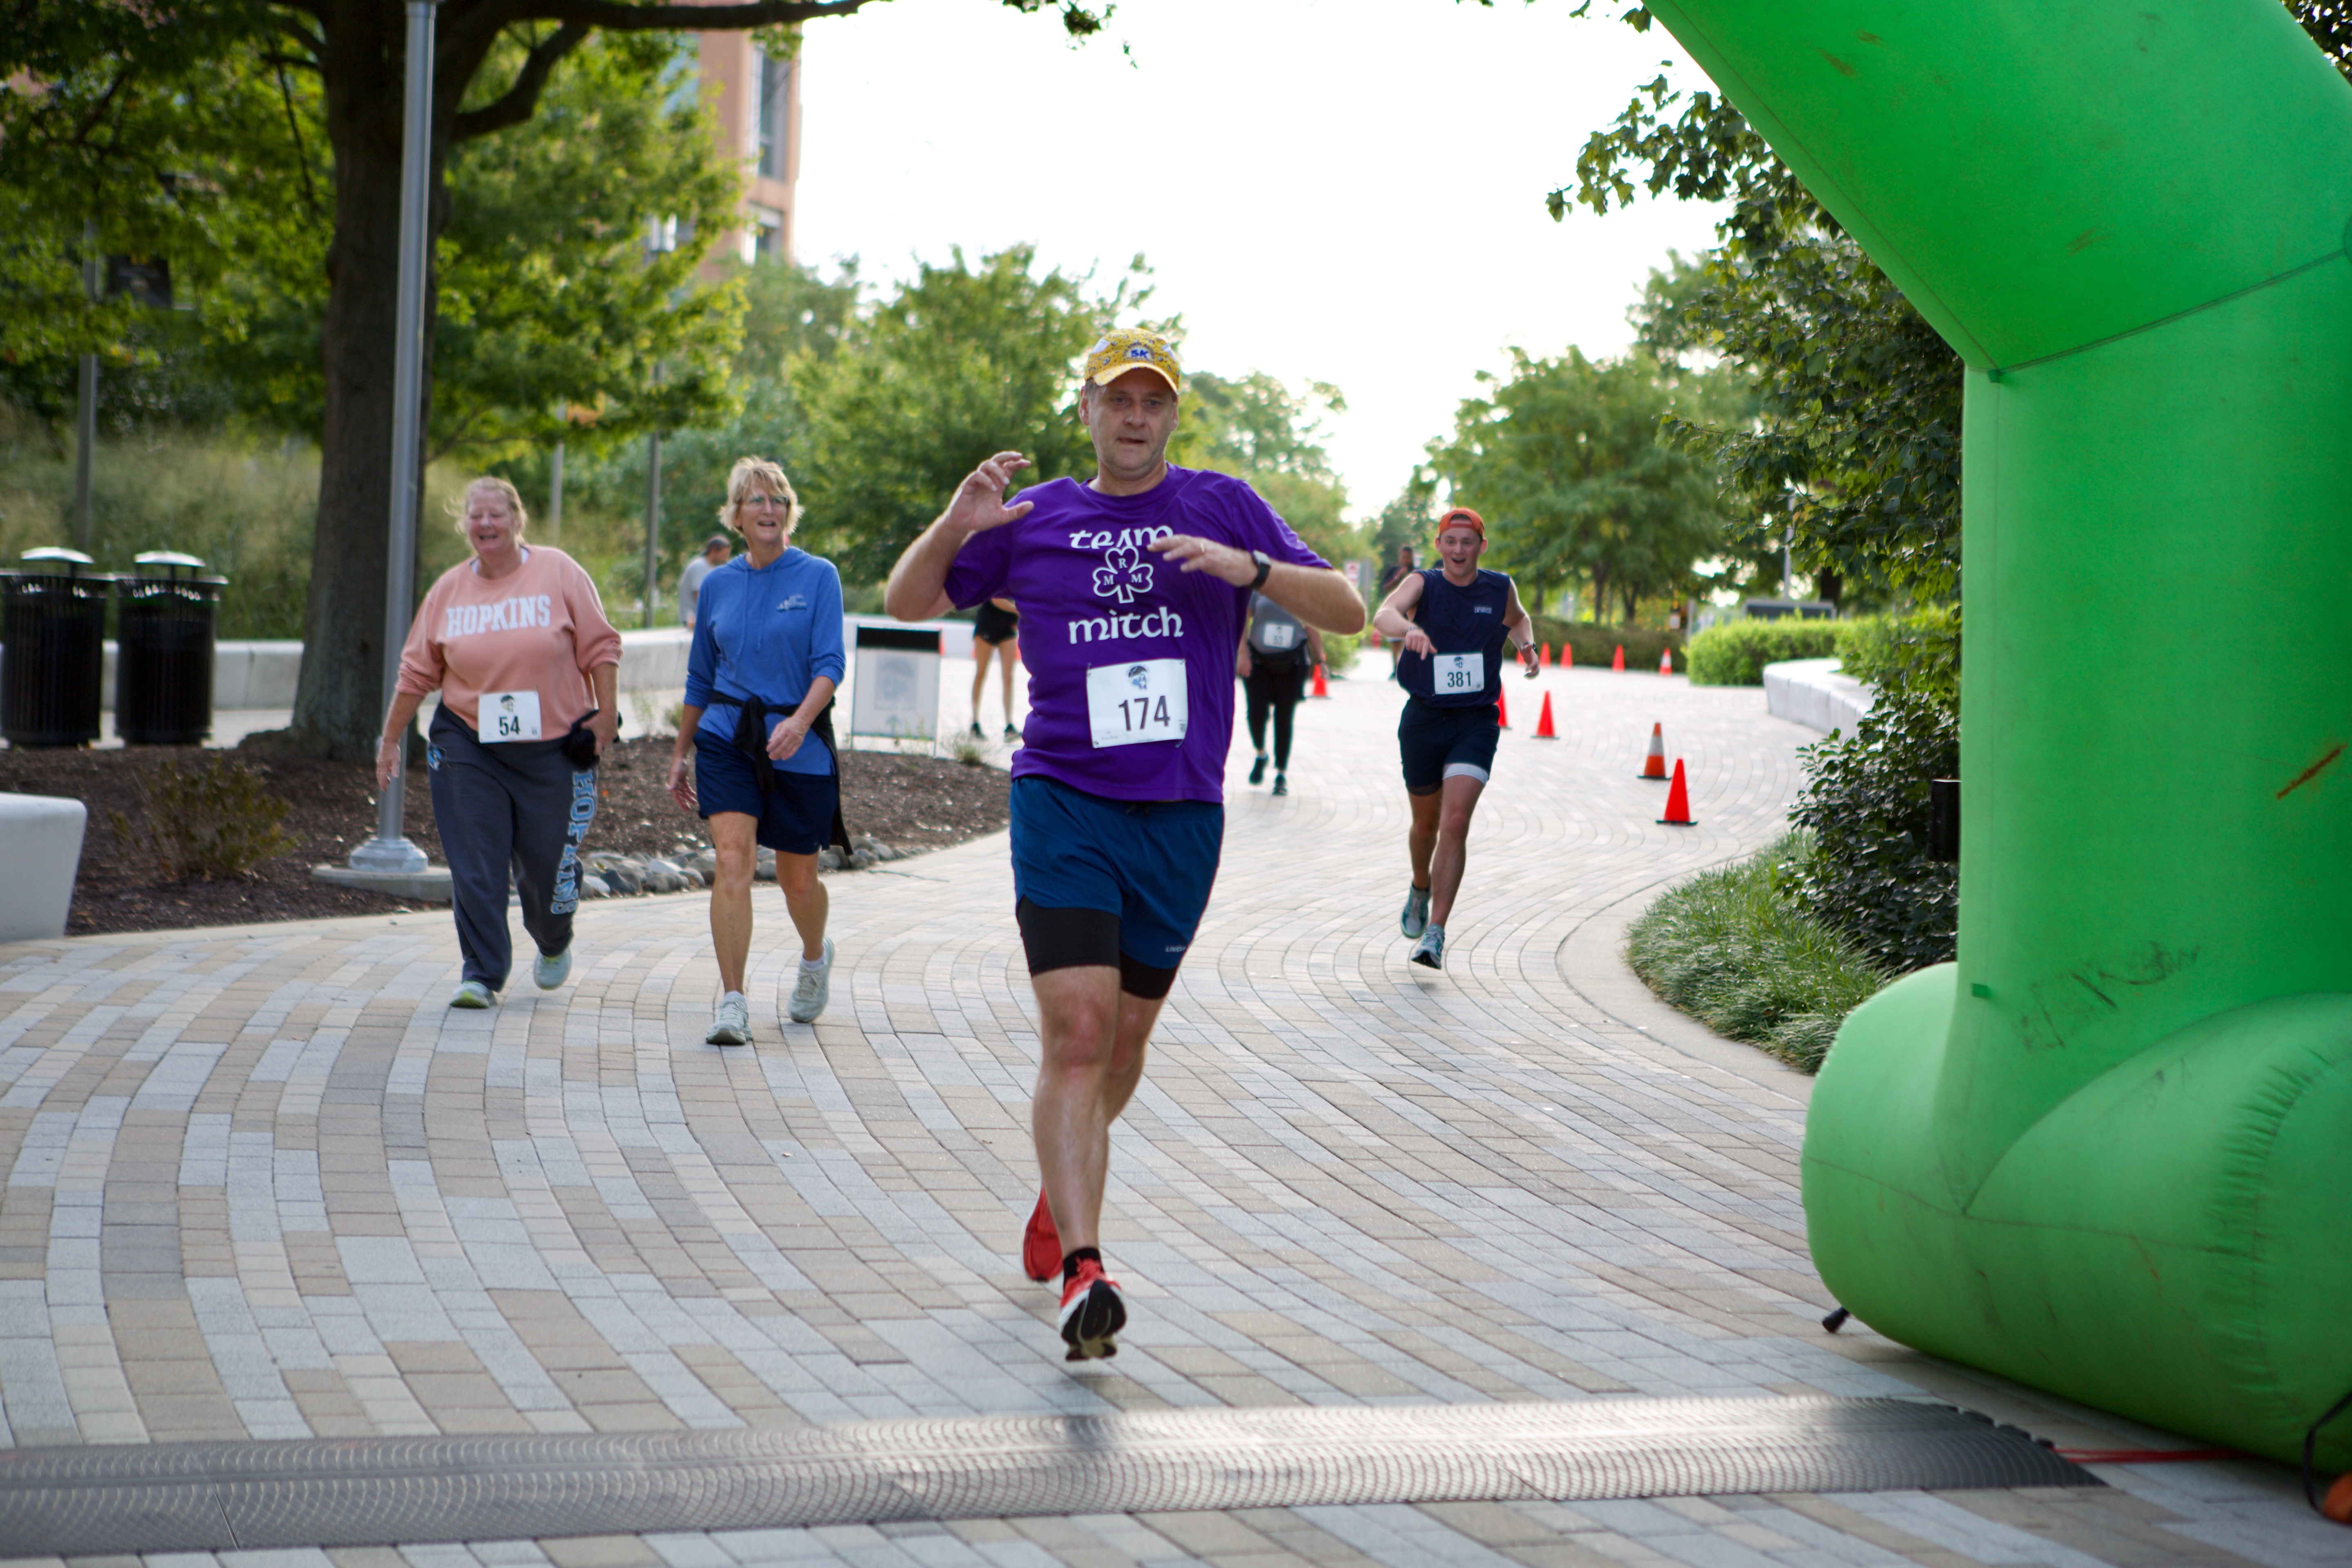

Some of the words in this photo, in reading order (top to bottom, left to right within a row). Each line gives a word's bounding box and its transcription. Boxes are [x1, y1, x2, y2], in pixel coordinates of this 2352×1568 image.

[1131, 350, 1149, 359] 5K
[1069, 525, 1174, 550] team
[1118, 558, 1127, 569] R
[1103, 575, 1114, 586] M
[1131, 573, 1143, 584] M
[445, 595, 551, 638] HOPKINS
[1069, 606, 1184, 645] mitch
[1274, 634, 1283, 645] 53
[1447, 671, 1471, 688] 381
[1118, 695, 1171, 732] 174
[499, 715, 521, 736] 54
